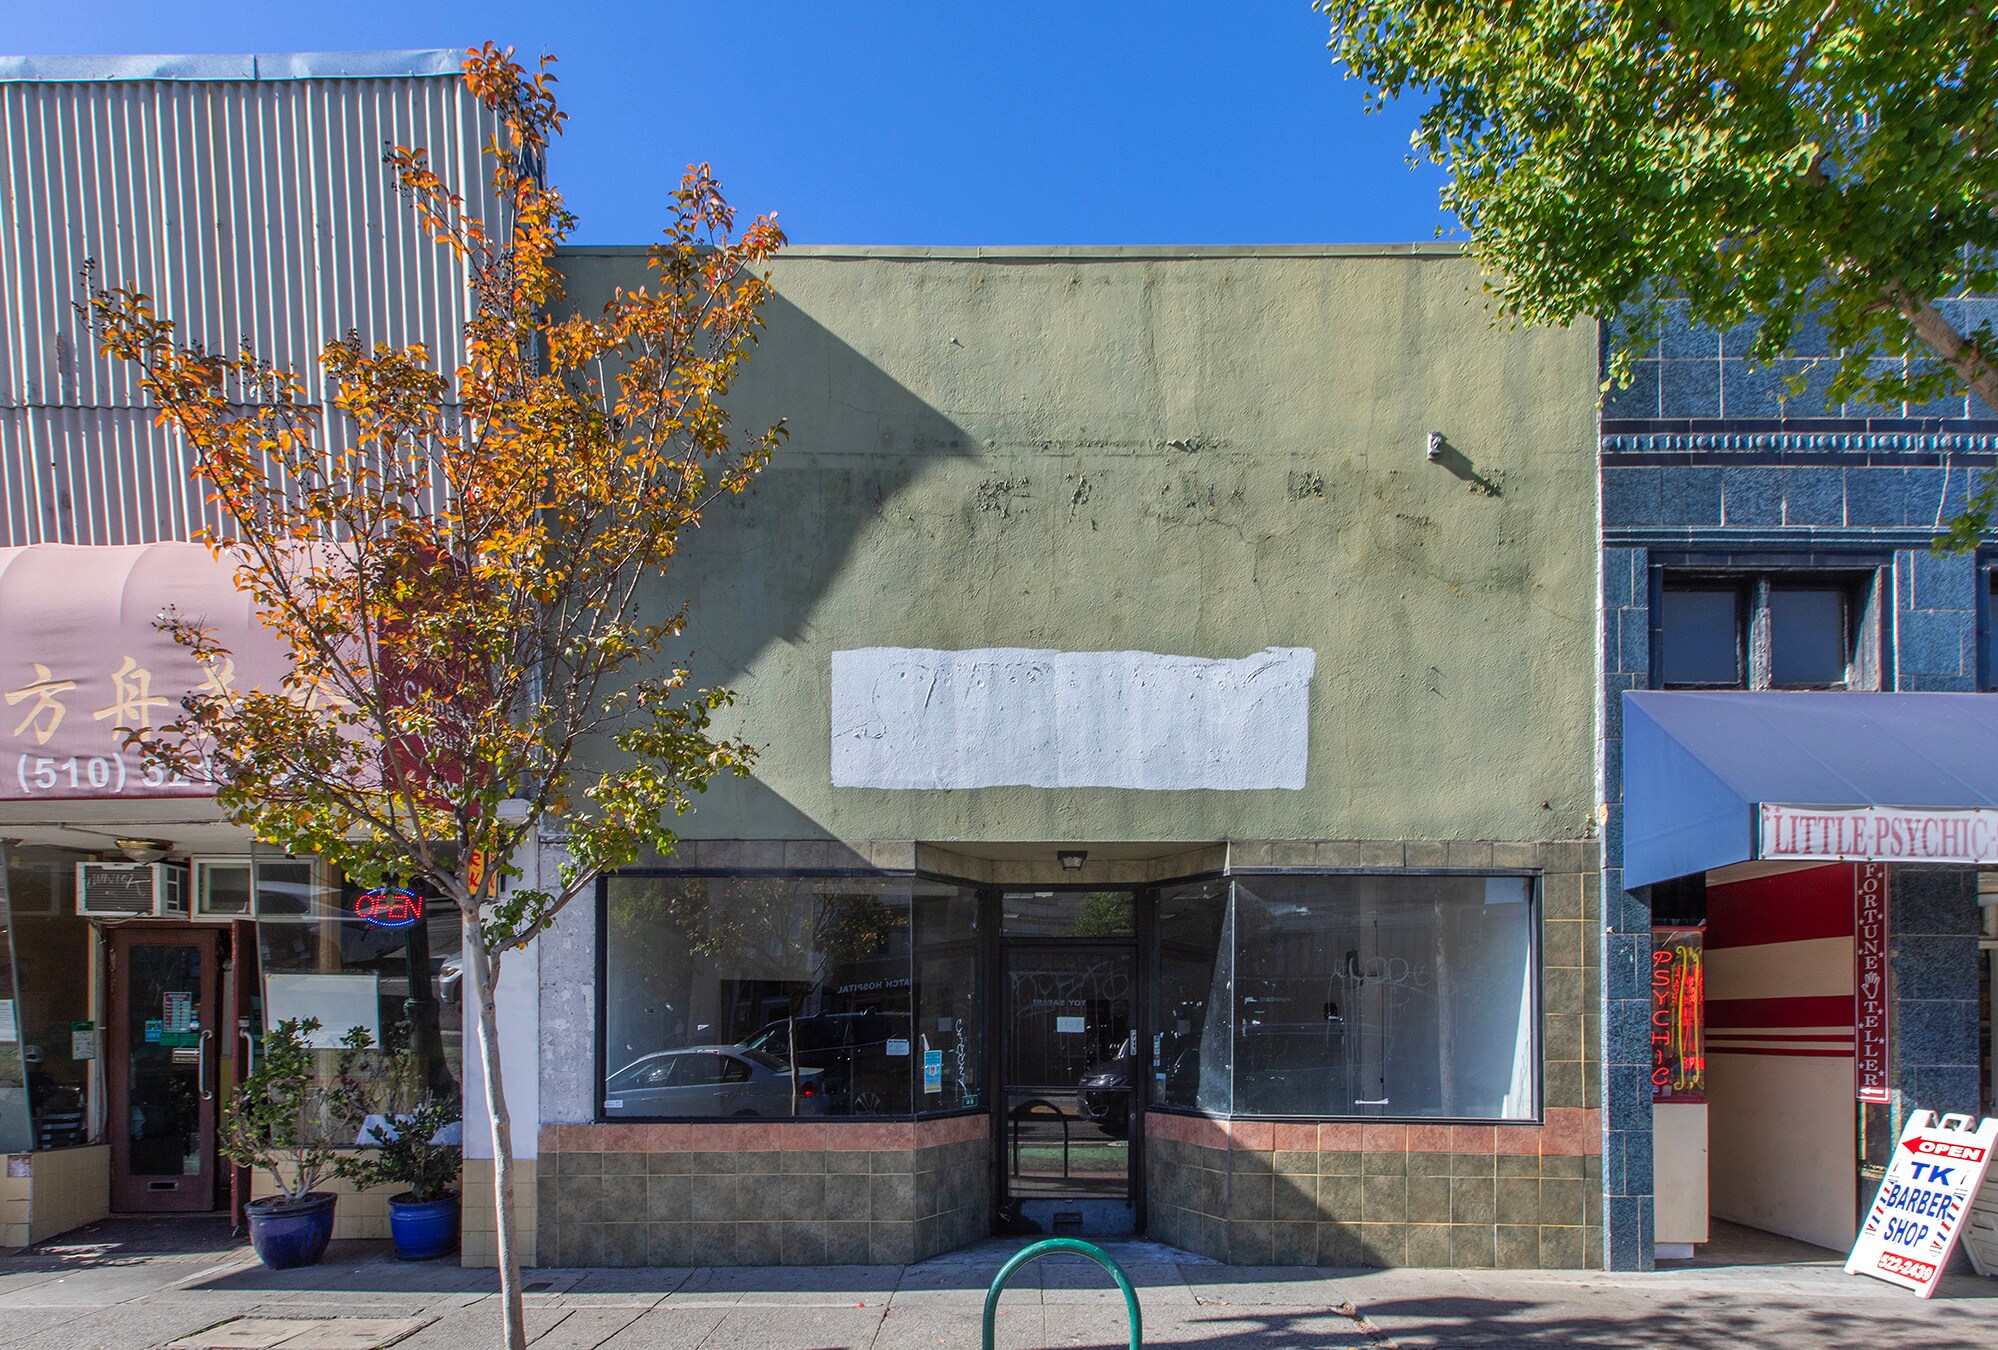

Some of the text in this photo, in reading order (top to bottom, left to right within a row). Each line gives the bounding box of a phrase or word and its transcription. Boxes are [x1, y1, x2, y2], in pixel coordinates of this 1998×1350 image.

[17, 752, 126, 794] (510)
[1773, 814, 1867, 855] LITTLE
[1874, 817, 1989, 859] PSYCHIC
[354, 894, 423, 919] OPEN
[1862, 863, 1879, 970] FORTUNE
[1651, 950, 1673, 1086] PSYCHIC
[1862, 1001, 1879, 1086] TELLER
[1918, 1140, 1982, 1161] OPEN
[1910, 1160, 1956, 1187] TK
[1886, 1184, 1953, 1220] BARBER
[1884, 1217, 1929, 1247] SHOP
